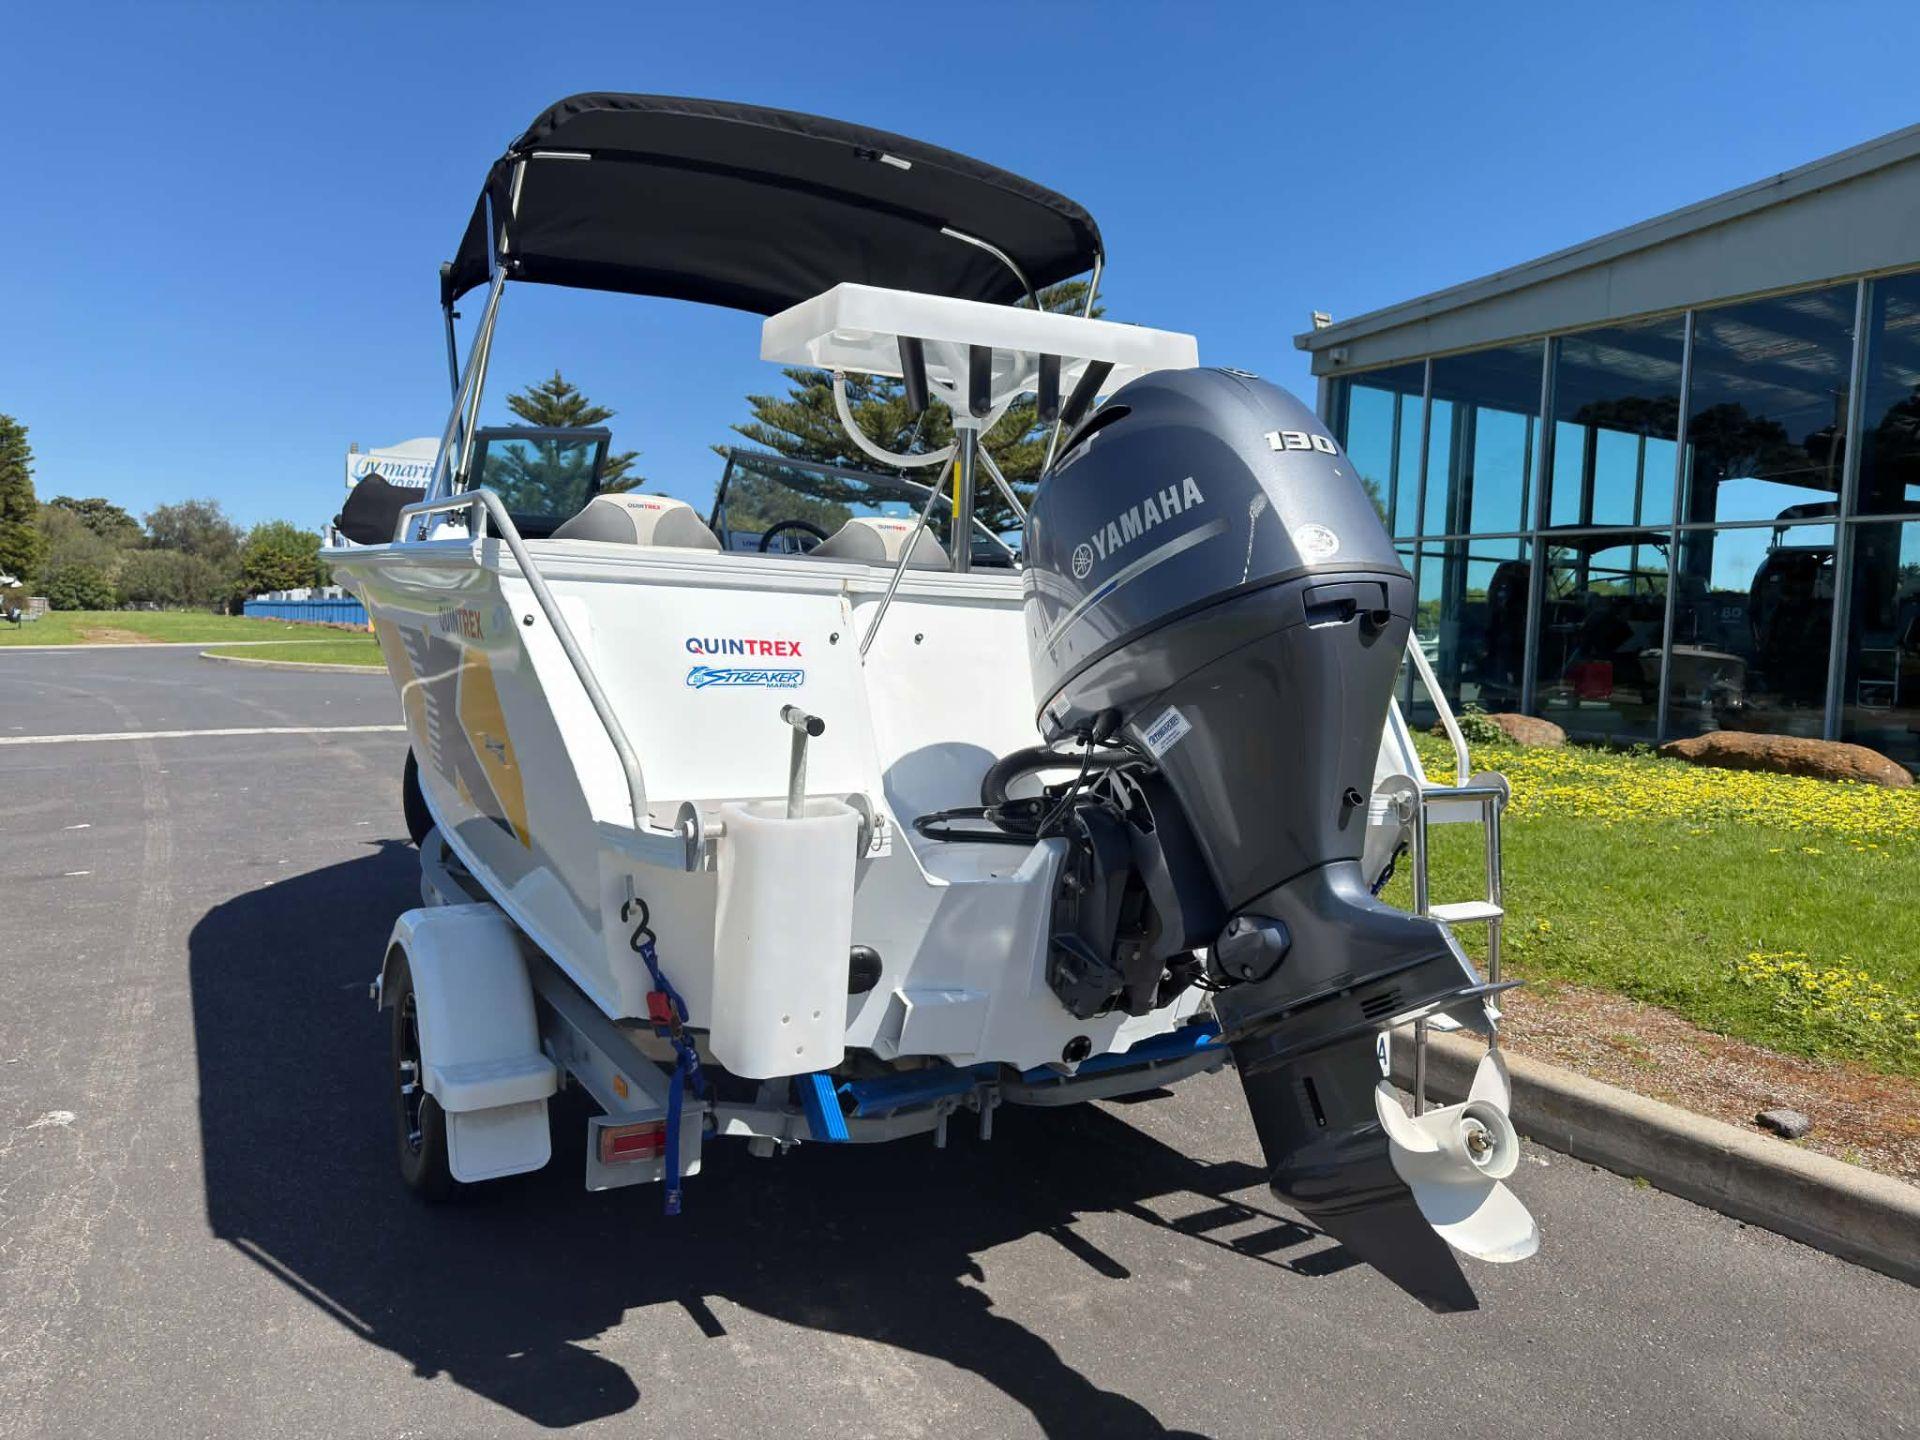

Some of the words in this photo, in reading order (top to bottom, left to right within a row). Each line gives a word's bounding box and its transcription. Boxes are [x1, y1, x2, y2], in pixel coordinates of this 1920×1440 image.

[1264, 430, 1338, 455] 130
[1091, 476, 1205, 561] YAMAHA
[685, 637, 803, 657] QUINTREX
